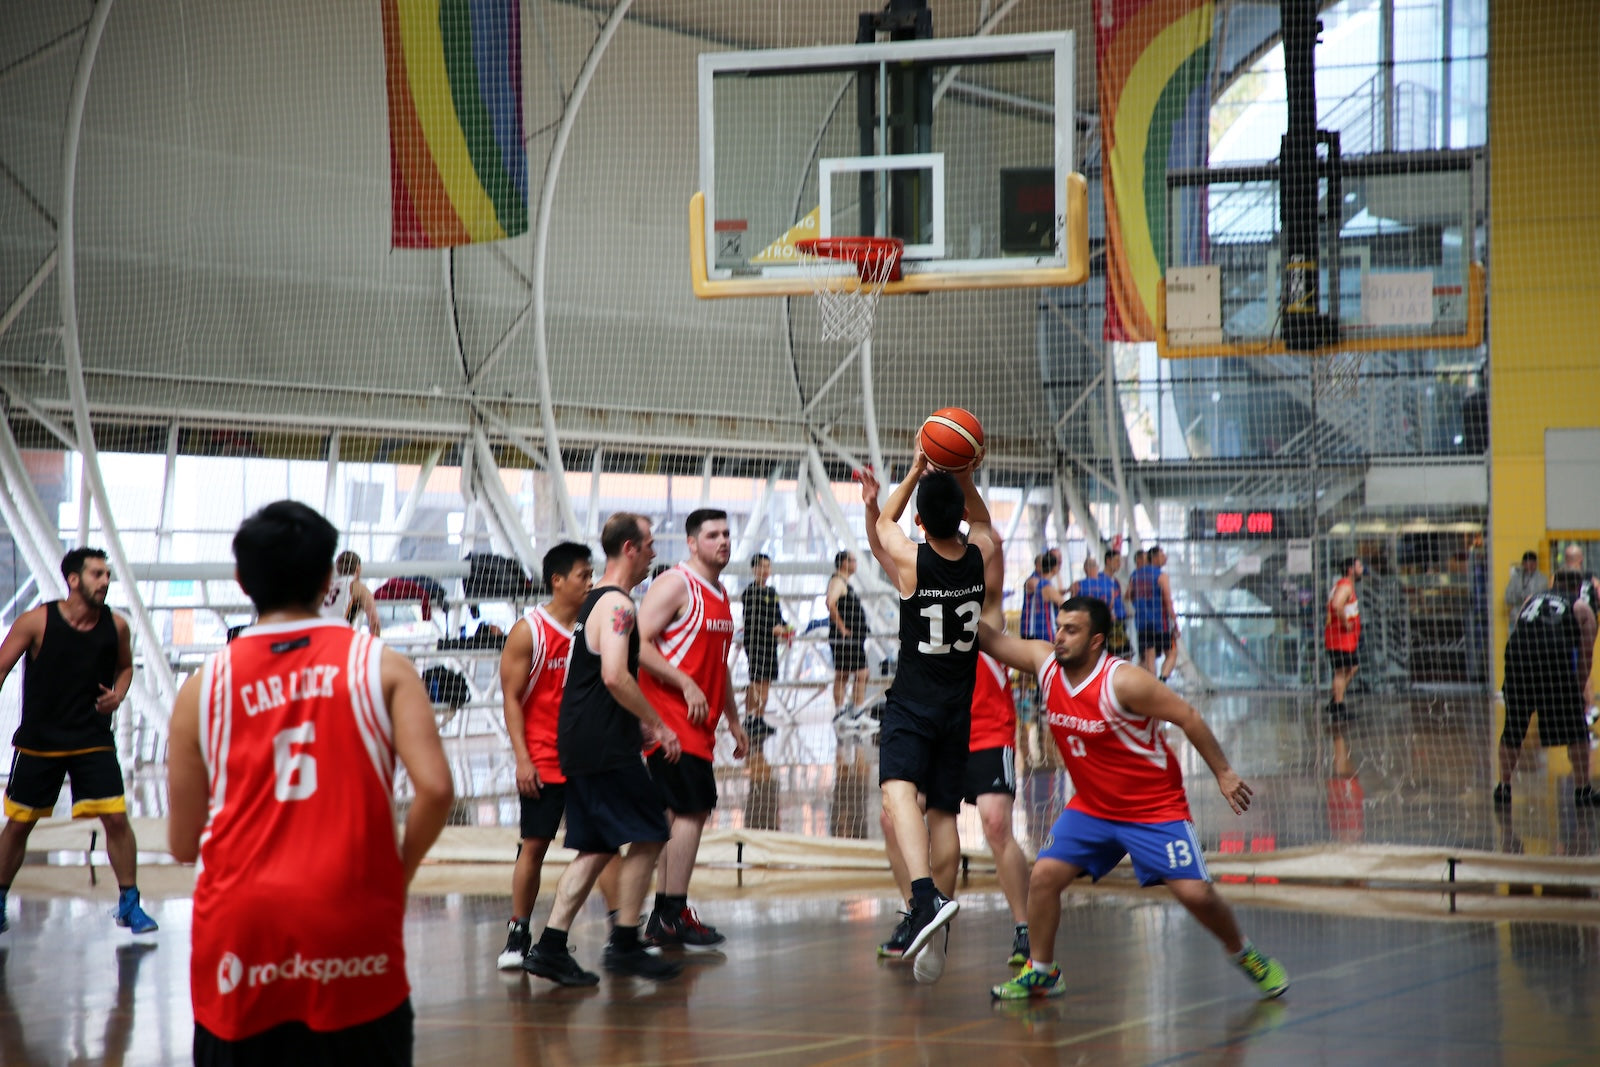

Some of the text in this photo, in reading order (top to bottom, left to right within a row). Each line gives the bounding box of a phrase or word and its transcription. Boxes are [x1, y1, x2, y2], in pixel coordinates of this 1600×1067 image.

[918, 584, 983, 597] JUSTPLAY.COM.AU
[917, 601, 981, 654] 13
[273, 721, 317, 802] 6
[1165, 839, 1193, 869] 13
